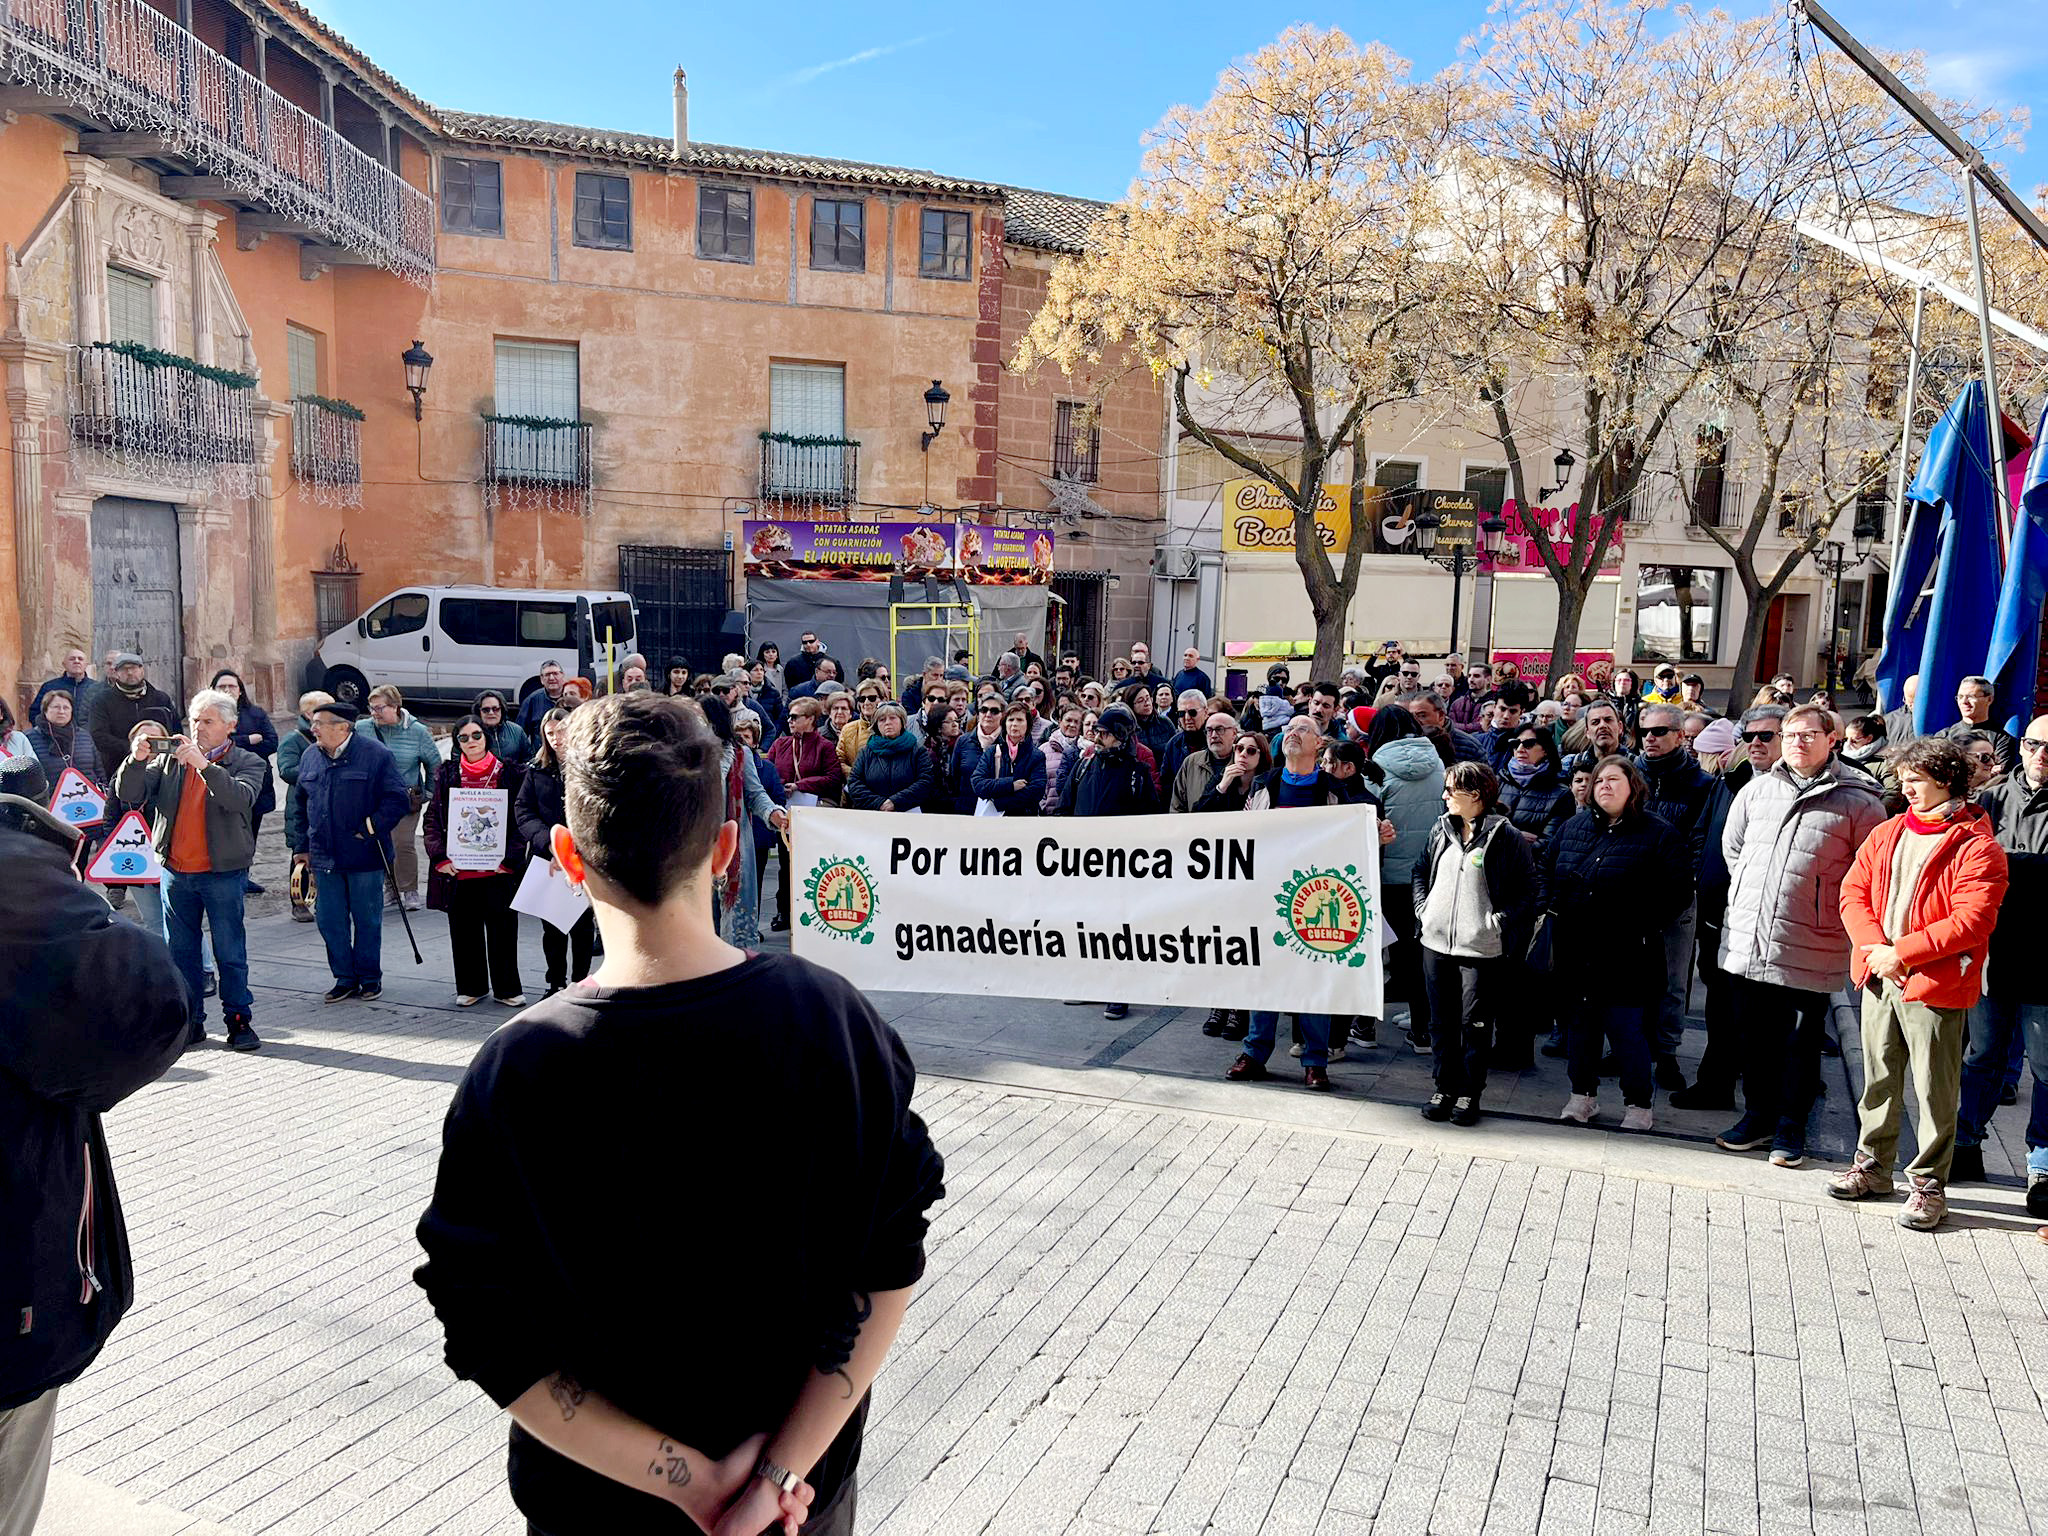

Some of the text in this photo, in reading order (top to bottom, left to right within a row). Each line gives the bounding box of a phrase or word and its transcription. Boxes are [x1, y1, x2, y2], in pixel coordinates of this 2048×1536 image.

[1434, 495, 1475, 510] Chocolate
[1439, 513, 1474, 528] Churros
[814, 524, 880, 535] PATATAS ASADAS
[1234, 515, 1337, 547] Beatiz
[814, 536, 883, 548] CON GUARNICIÓN
[804, 550, 892, 566] EL HORTELANO
[987, 555, 995, 568] EL
[890, 837, 1255, 881] Por una Cuenca SIN
[818, 866, 869, 900] PUEBLOS VIVOS
[1292, 879, 1359, 917] PUEBLOS VIVOS
[827, 910, 858, 921] CUENCA
[1307, 928, 1346, 941] CUENCA
[895, 918, 1261, 967] ganadería industrial
